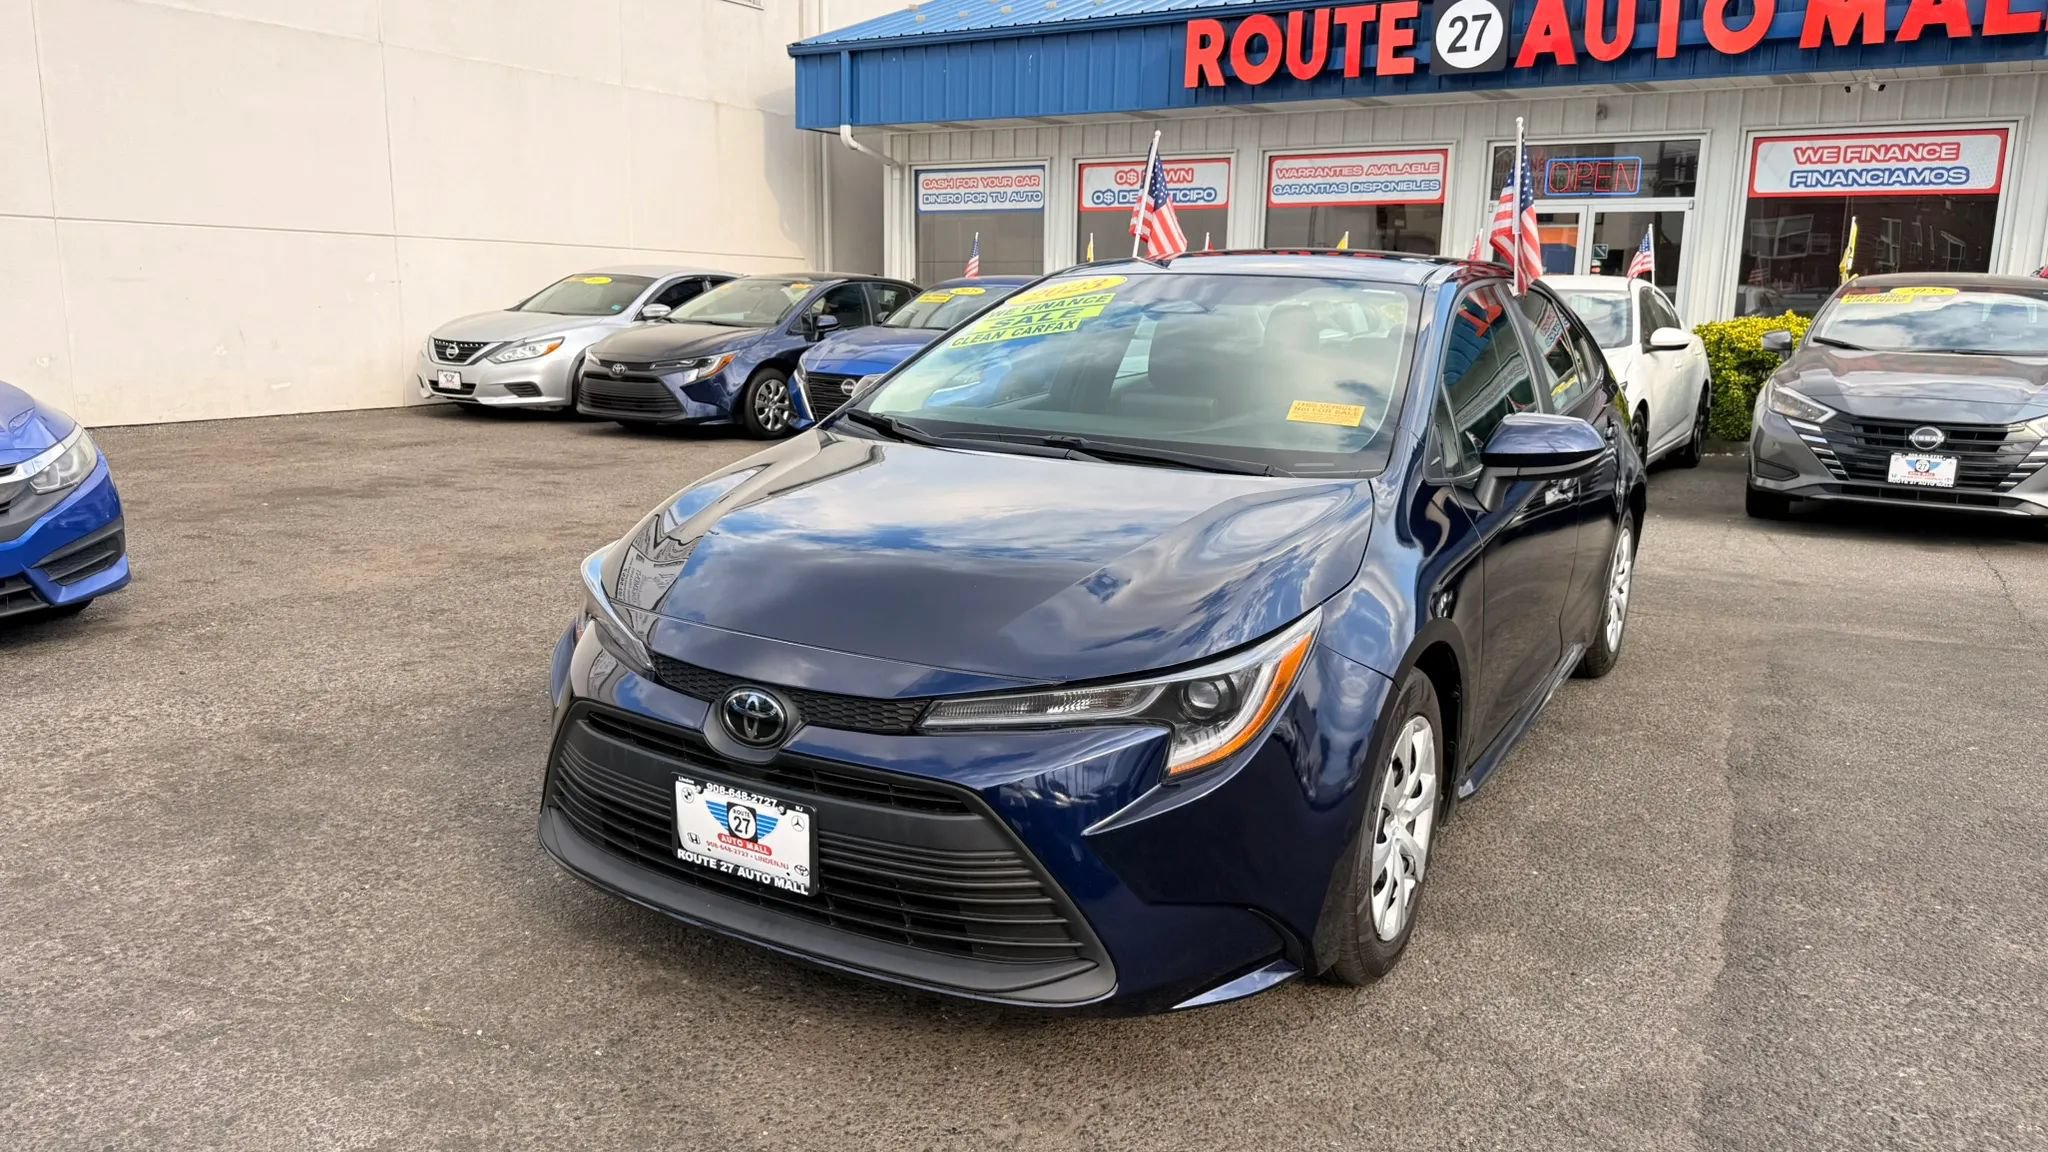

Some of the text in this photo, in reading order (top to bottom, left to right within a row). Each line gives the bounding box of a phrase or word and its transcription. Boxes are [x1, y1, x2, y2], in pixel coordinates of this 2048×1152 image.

[1184, 0, 2048, 88] ROUTE 27 AUTO MAL
[1793, 142, 1960, 165] WE FINANCE
[1276, 162, 1439, 179] WARRANTIES AVAILABLE
[1549, 160, 1638, 192] OPEN
[1790, 166, 1969, 189] FINANCIAMOS
[923, 175, 1040, 190] CASH FOR YOUR CAR
[1273, 179, 1441, 196] GARANTIAS DISPONIBLES
[923, 191, 1042, 205] DINERO POR TU AUTO
[1022, 293, 1115, 312] FINANCE
[990, 308, 1084, 329] SALE
[952, 320, 1078, 346] CLEAN CARFAX
[1909, 434, 1945, 443] NISSAN
[706, 783, 777, 807] 908-648-2727
[733, 808, 751, 818] ROUTE
[733, 816, 751, 834] 27
[720, 835, 770, 854] AUTO MALL
[677, 849, 809, 895] ROUTE 27 AUTO MALL
